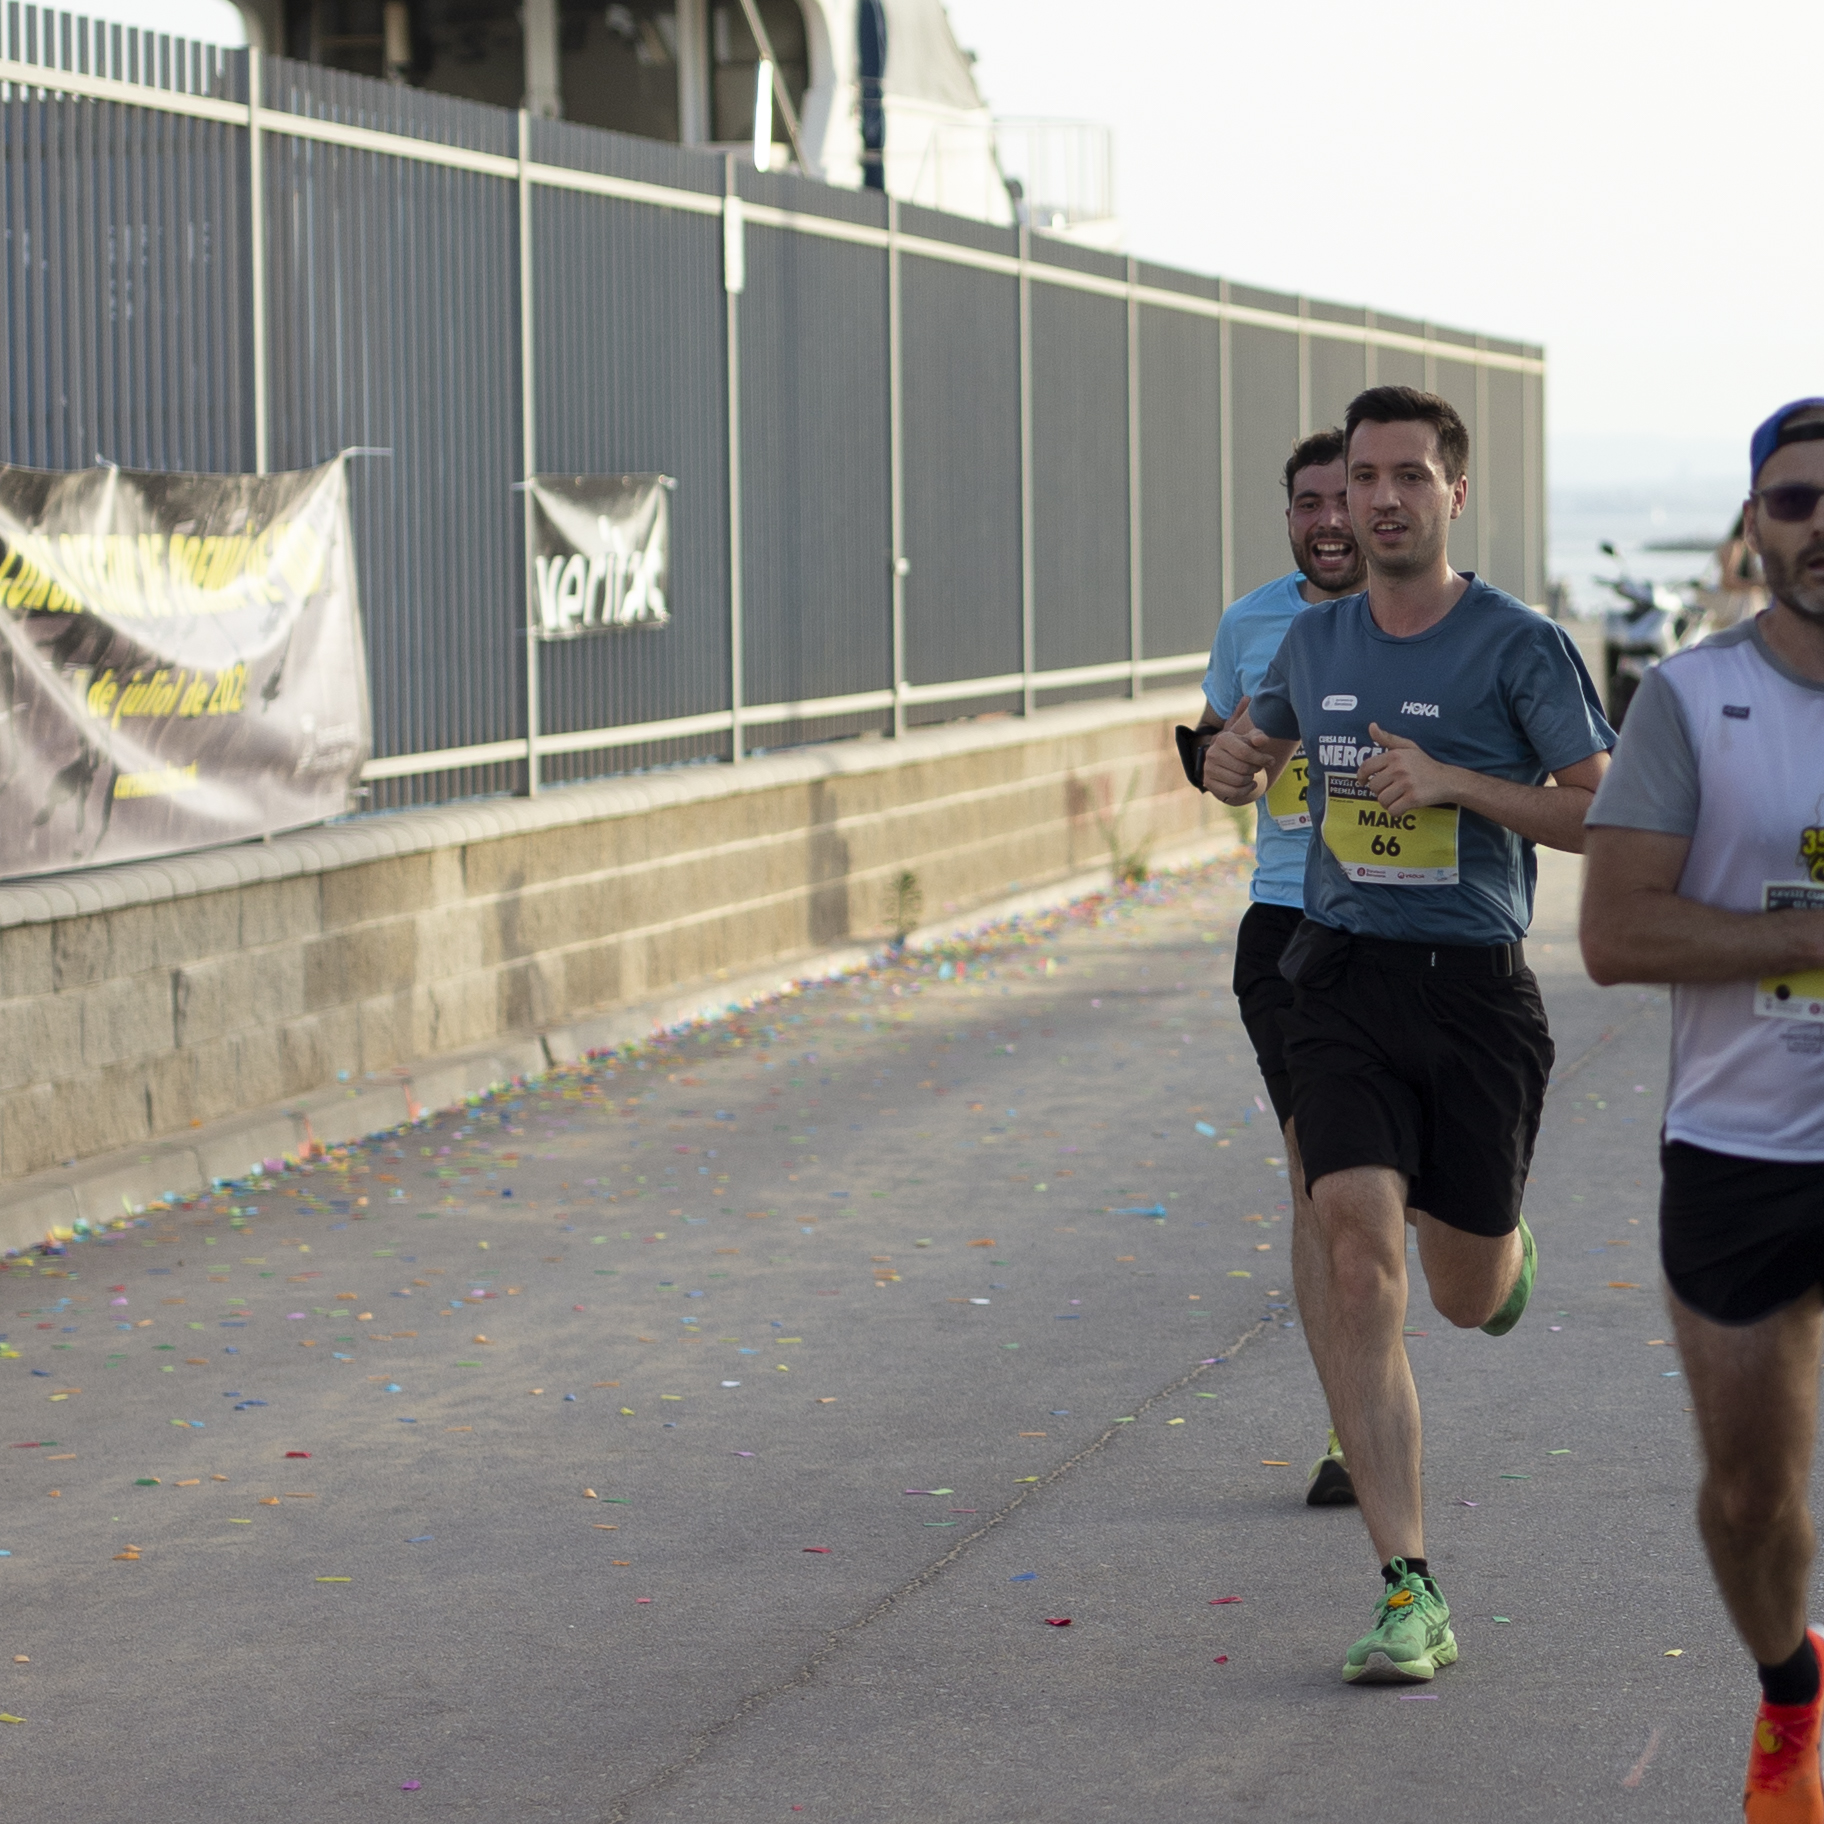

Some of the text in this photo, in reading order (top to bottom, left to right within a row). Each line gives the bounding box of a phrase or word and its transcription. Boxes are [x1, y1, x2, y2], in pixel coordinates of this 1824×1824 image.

[88, 669, 118, 717] de
[111, 669, 187, 729] juliol
[178, 669, 209, 717] de
[1401, 701, 1440, 718] HOKA
[1319, 735, 1337, 744] CURSA
[1348, 736, 1357, 744] LA
[1330, 786, 1356, 796] PREMIÀ
[1357, 789, 1368, 797] DE
[1358, 810, 1417, 831] MARC
[1371, 835, 1401, 857] 66
